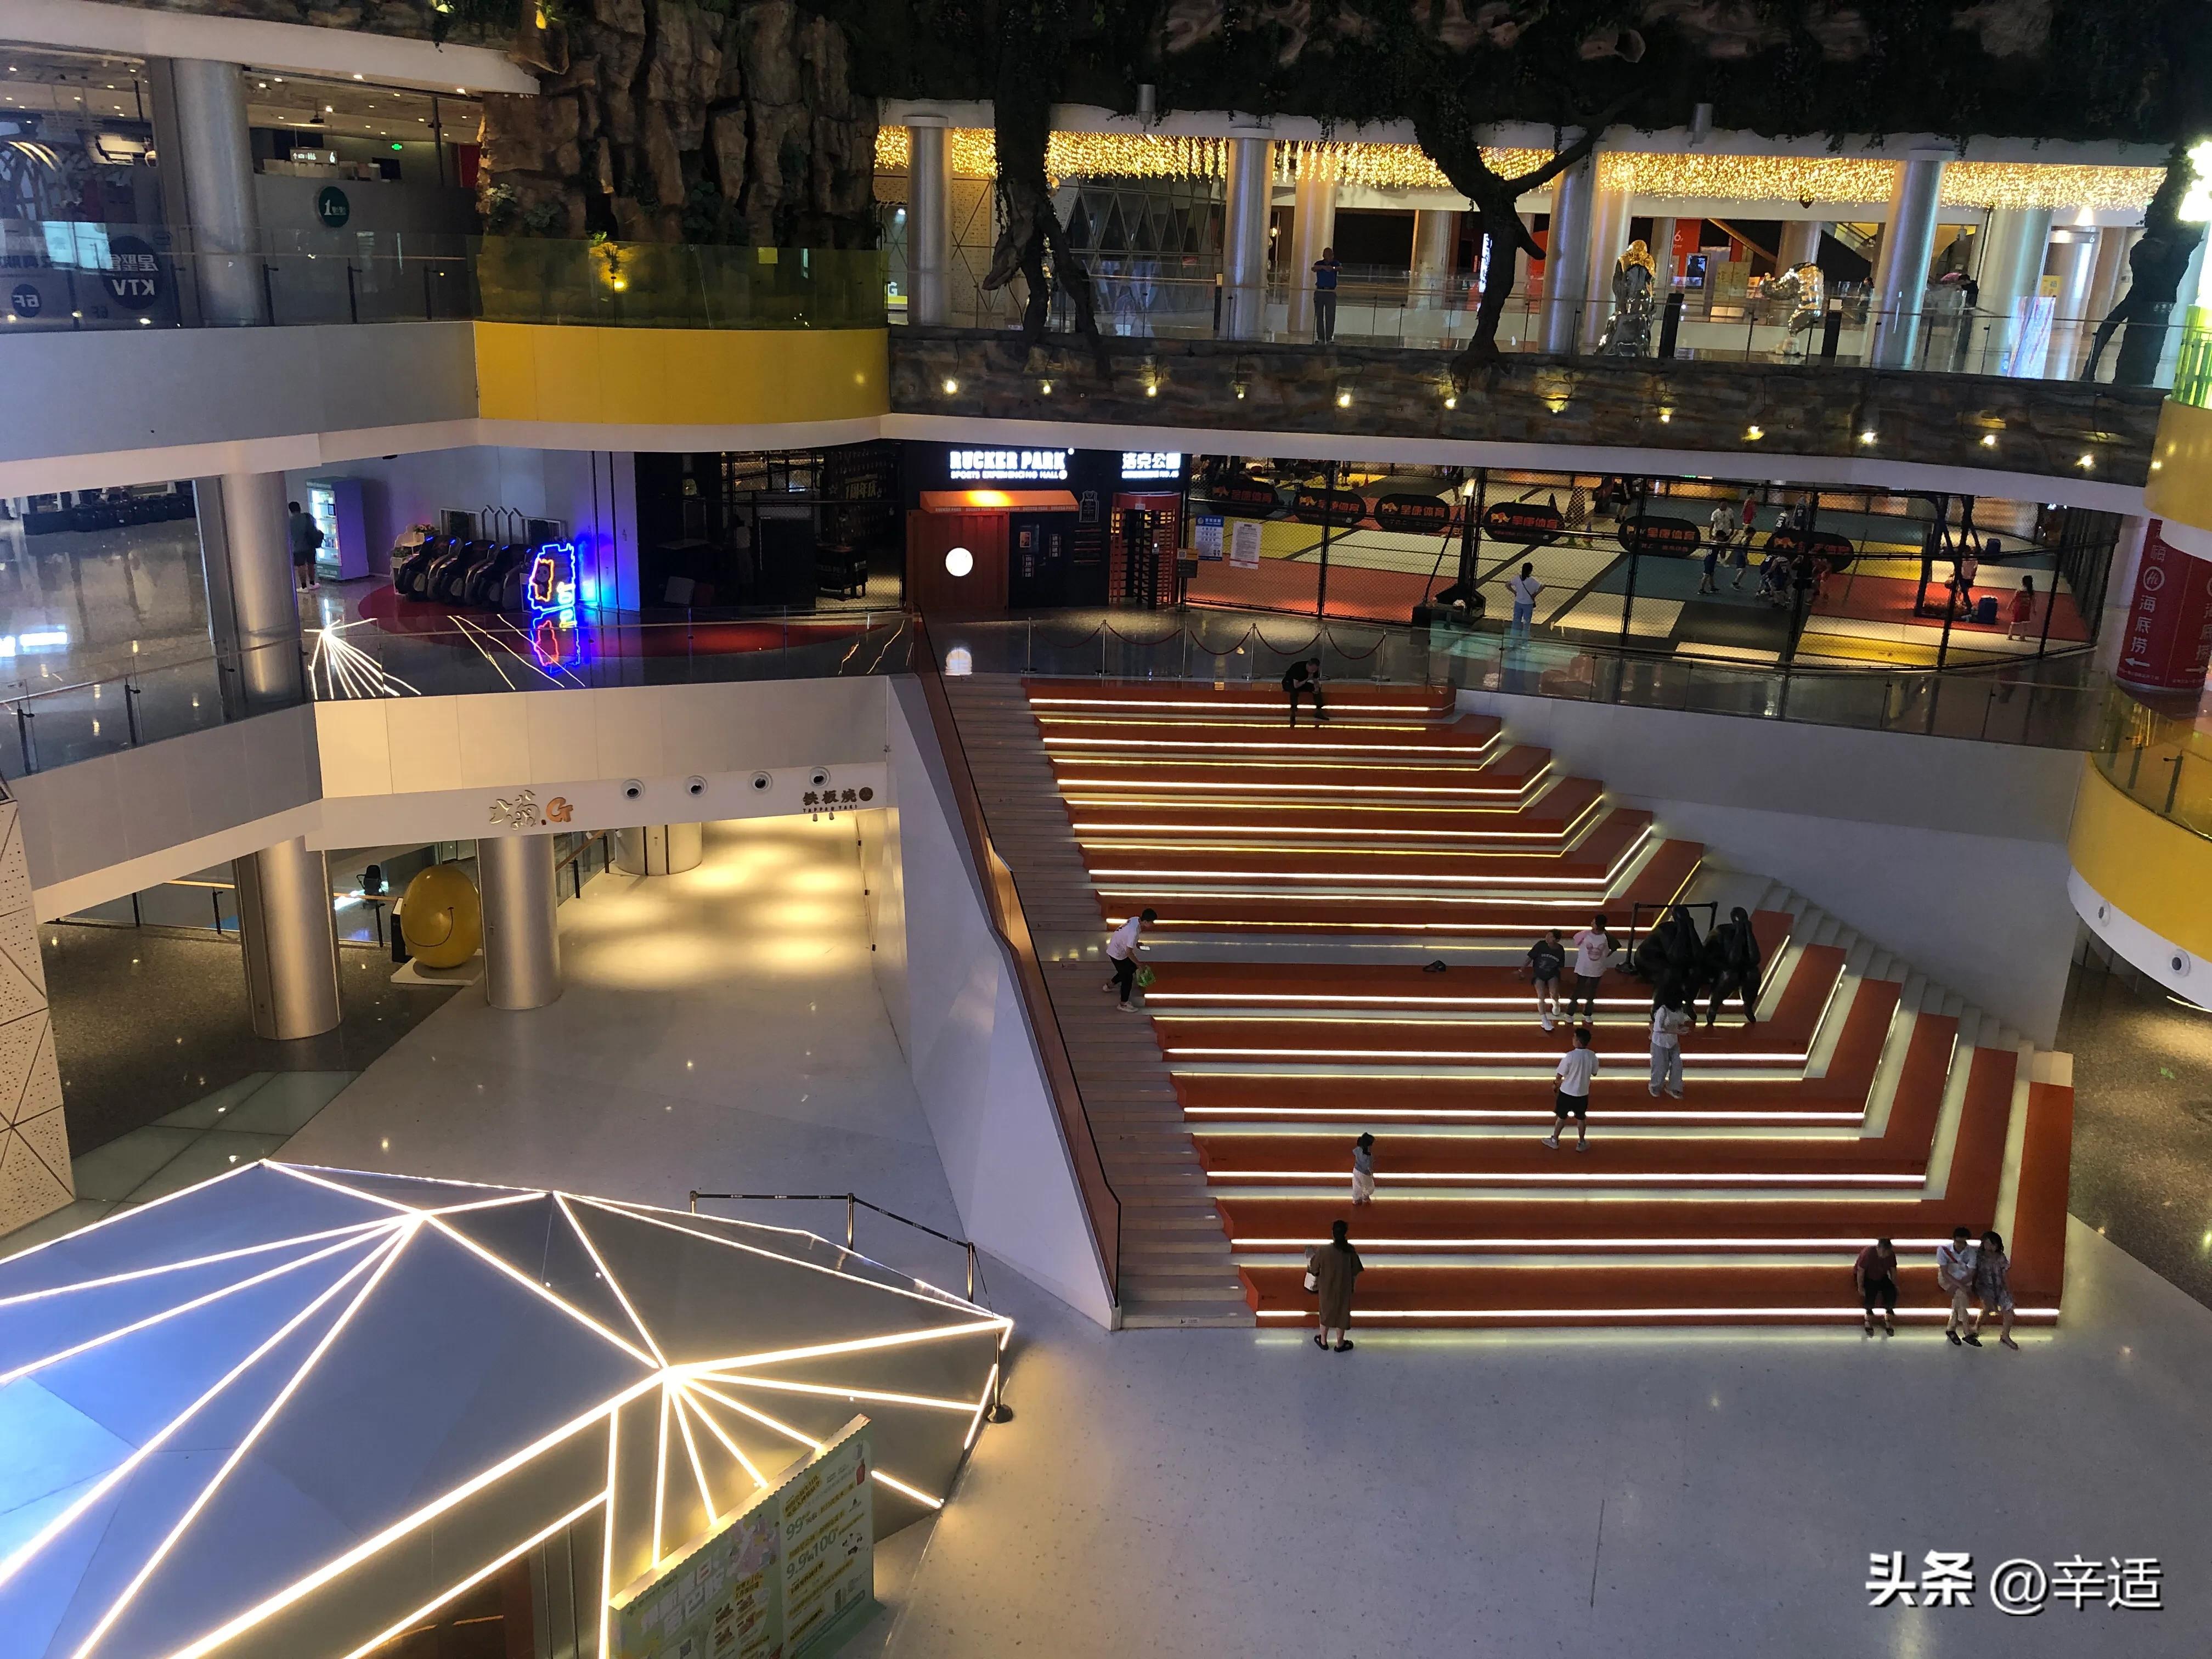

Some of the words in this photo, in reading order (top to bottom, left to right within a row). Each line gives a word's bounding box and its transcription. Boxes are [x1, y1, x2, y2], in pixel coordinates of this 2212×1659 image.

[2089, 234, 2095, 243] 6
[950, 451, 1017, 470] RUCKER
[1020, 452, 1065, 470] PARK
[2130, 595, 2157, 654] 海底捞
